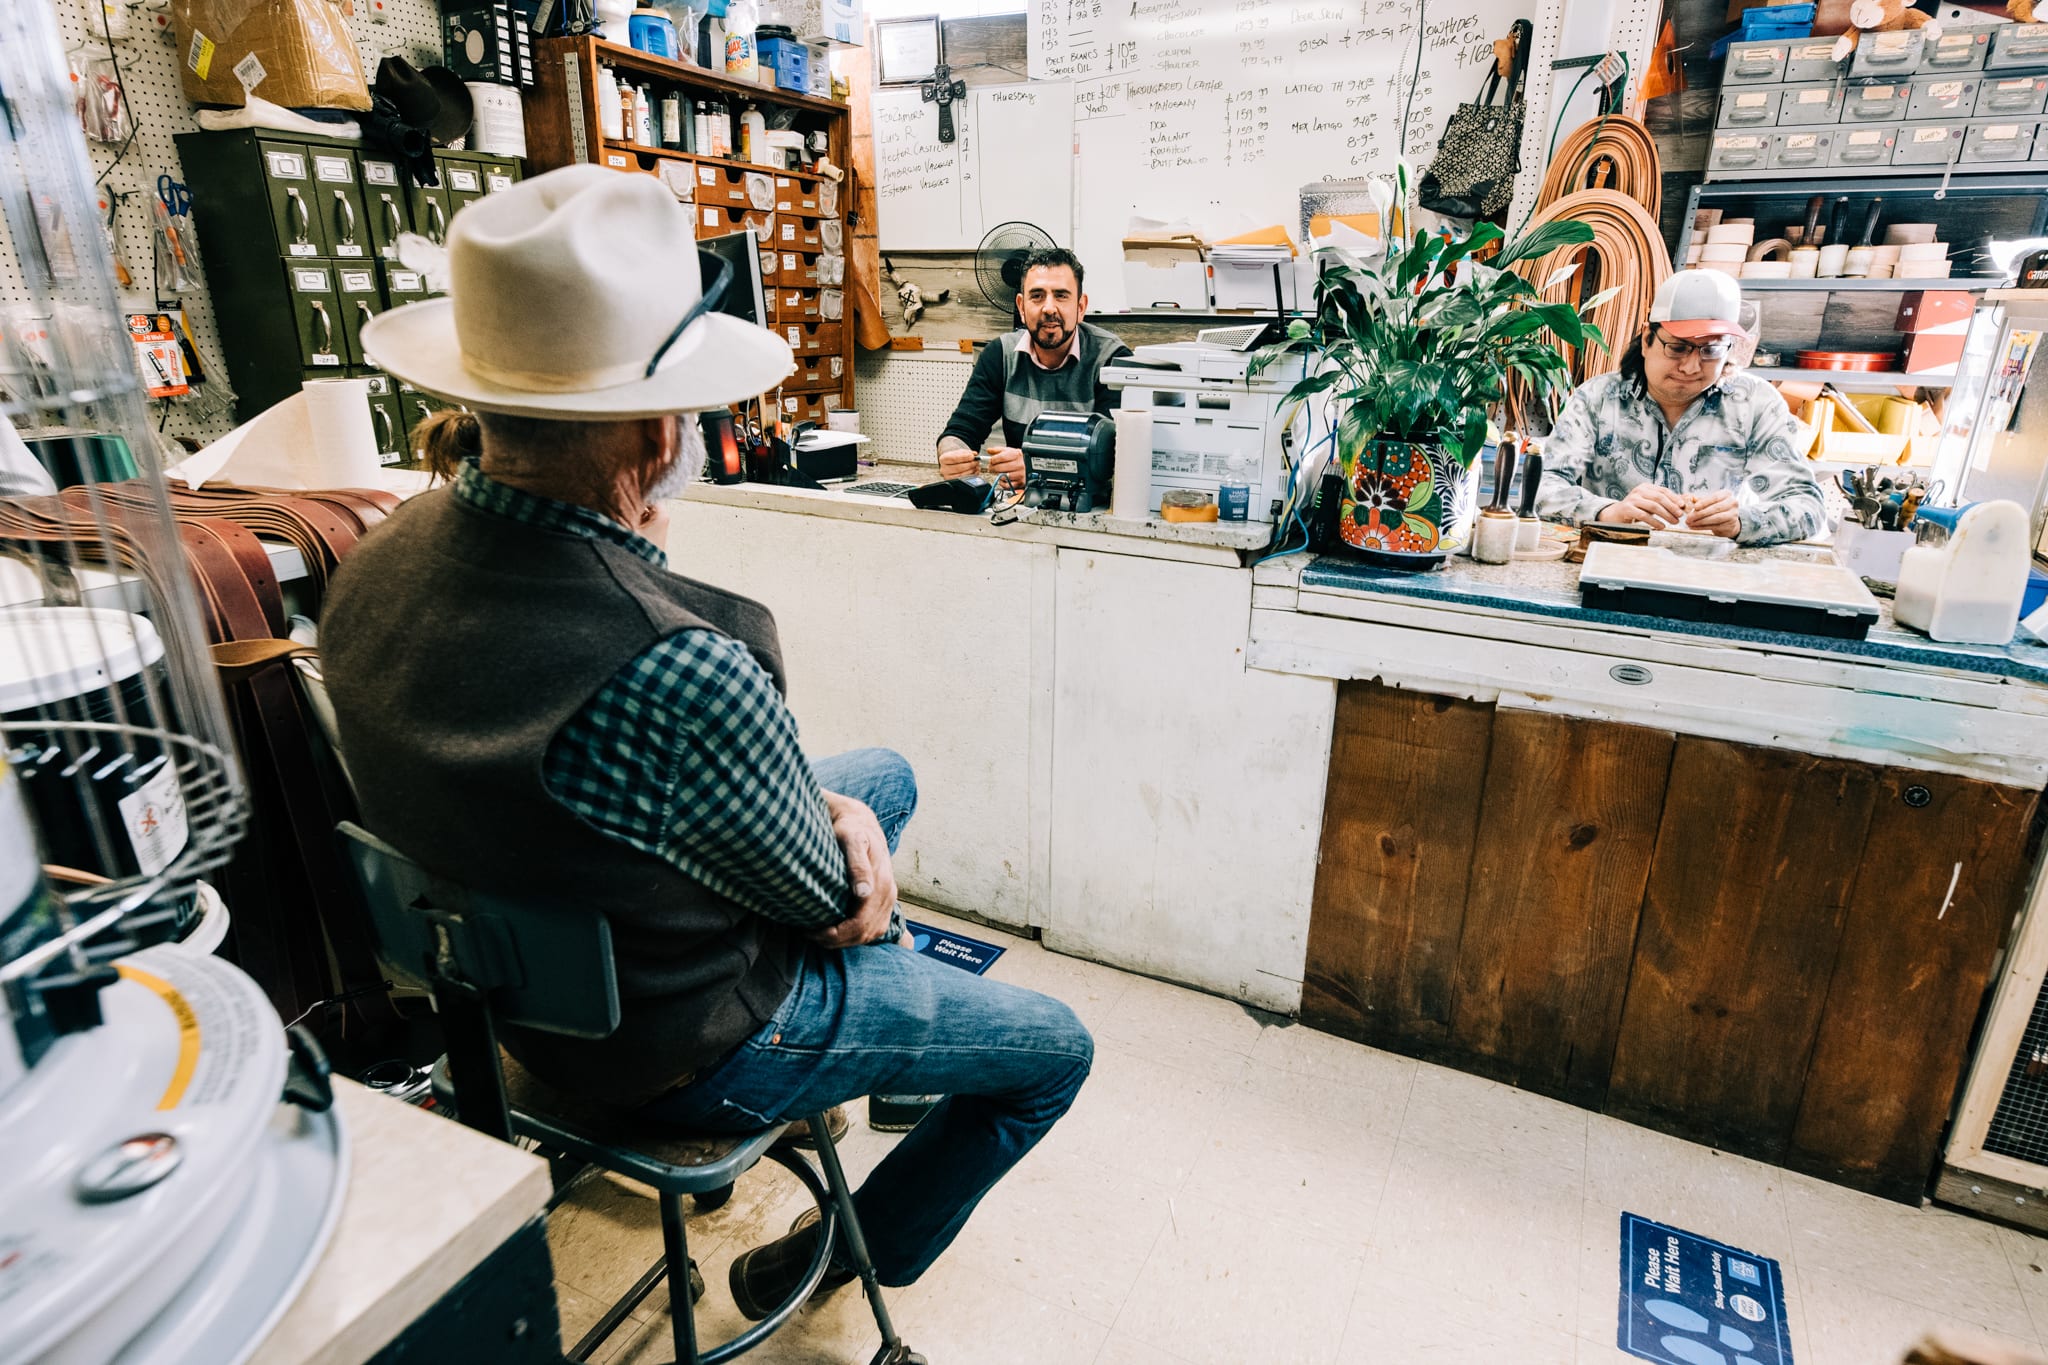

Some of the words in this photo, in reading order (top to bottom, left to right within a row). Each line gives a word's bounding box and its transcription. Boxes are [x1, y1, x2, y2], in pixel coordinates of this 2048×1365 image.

[1430, 34, 1460, 52] HAIR
[1284, 83, 1324, 94] LATIGO
[1150, 132, 1191, 145] WALNUT
[934, 944, 958, 956] Wait
[957, 952, 983, 964] Here
[939, 940, 972, 954] Please
[1664, 1236, 1680, 1266] Here
[1644, 1247, 1662, 1290] Please
[1664, 1266, 1681, 1294] Wait
